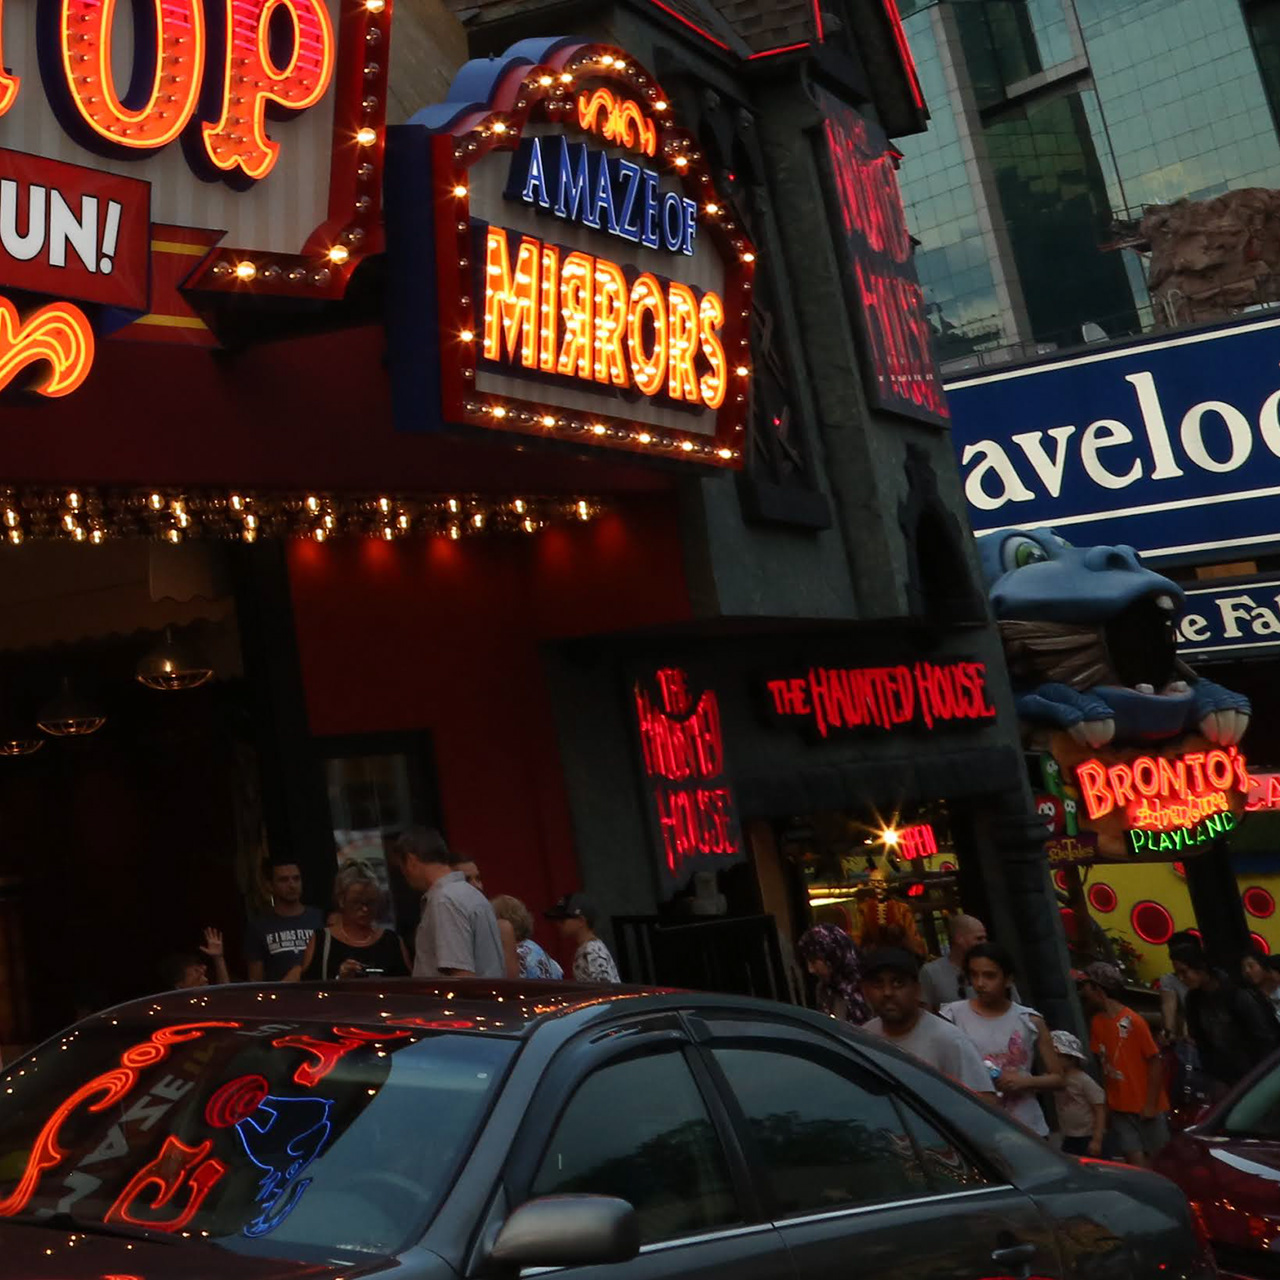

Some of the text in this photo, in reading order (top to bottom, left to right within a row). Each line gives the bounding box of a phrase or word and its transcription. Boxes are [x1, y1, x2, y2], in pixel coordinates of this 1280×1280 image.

[522, 135, 698, 256] A MAZE OF
[1173, 596, 1280, 643] e Fa
[768, 661, 996, 739] THE HAUNTED HOUSE
[1076, 745, 1249, 820] BRONTO'S
[901, 823, 939, 860] OPEN
[1129, 811, 1237, 854] PLAYLAND
